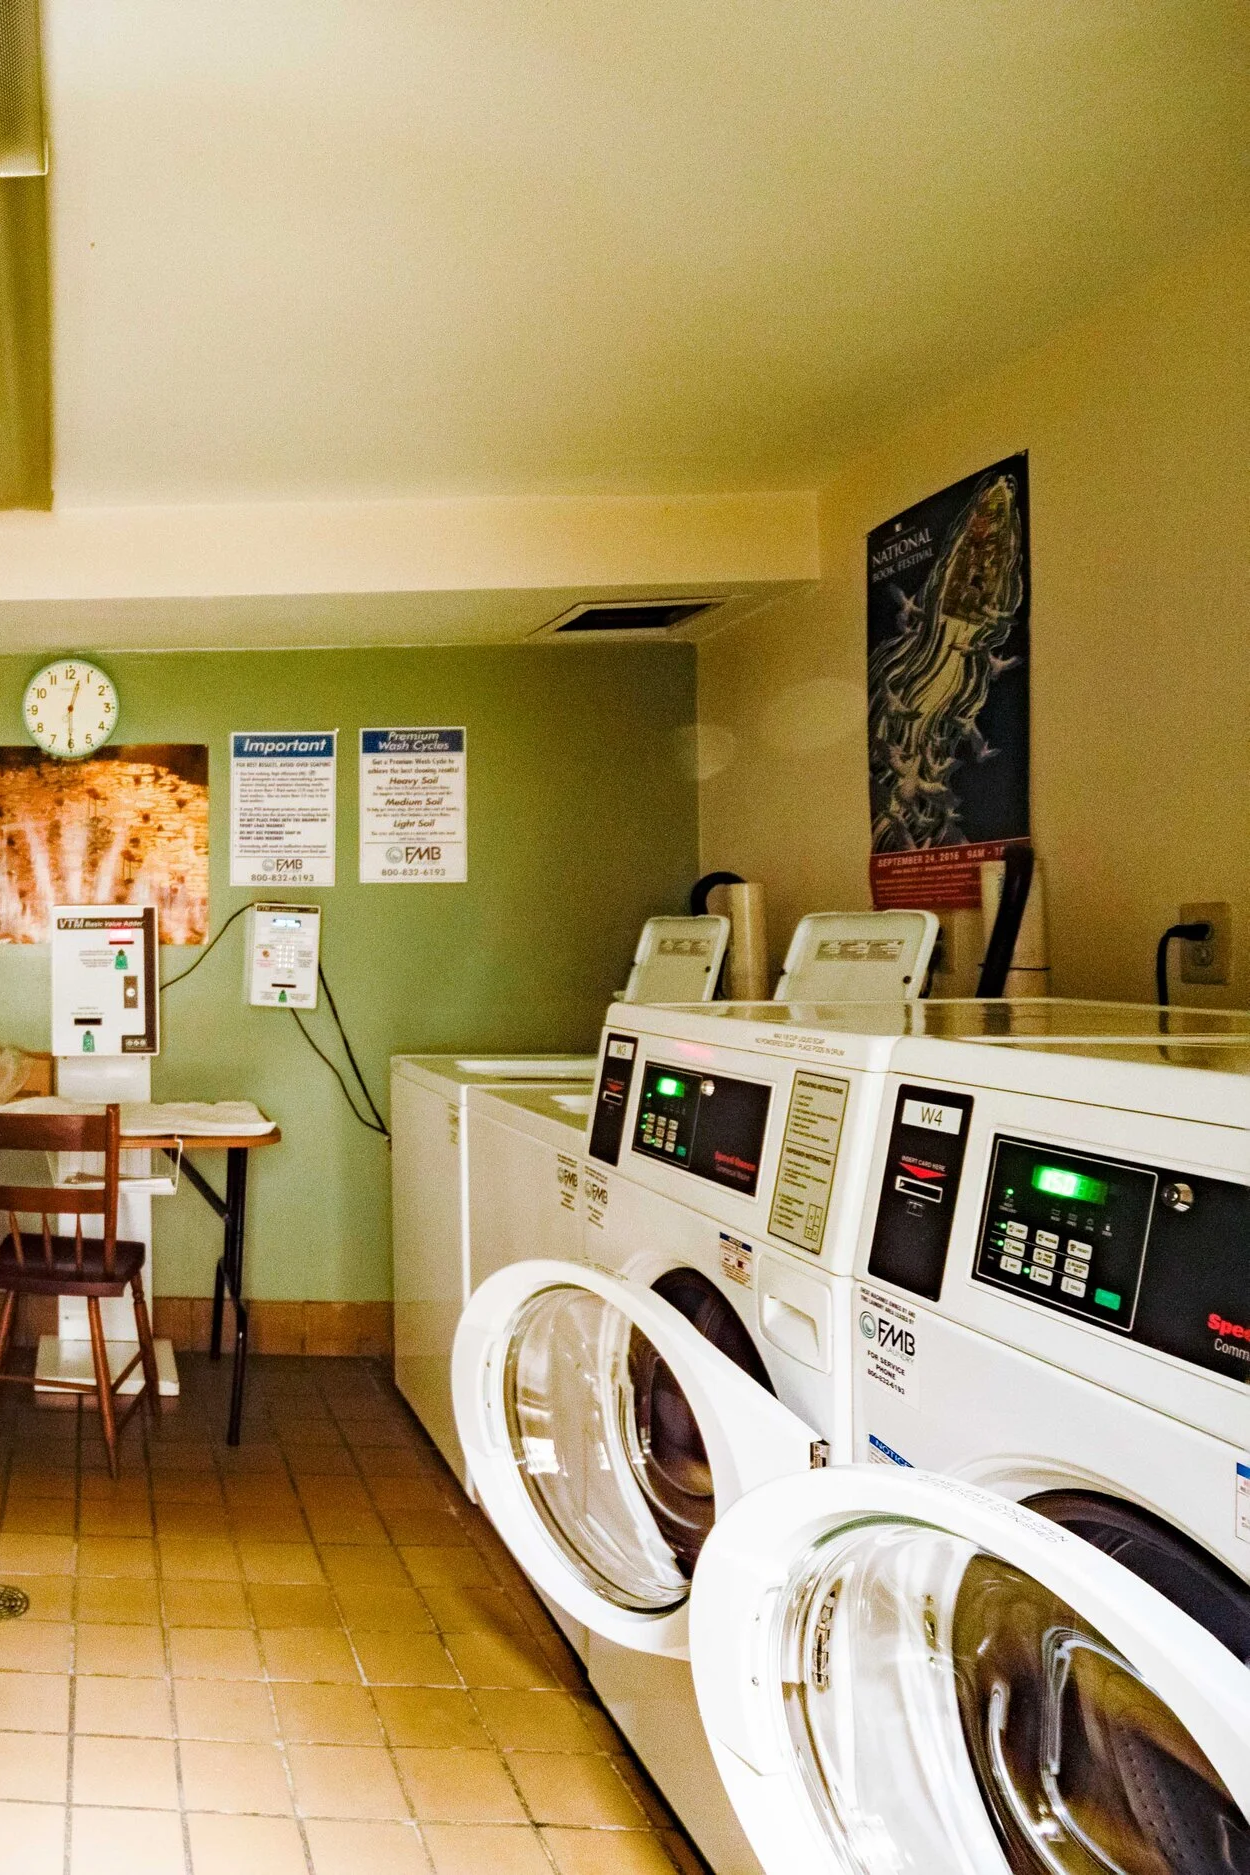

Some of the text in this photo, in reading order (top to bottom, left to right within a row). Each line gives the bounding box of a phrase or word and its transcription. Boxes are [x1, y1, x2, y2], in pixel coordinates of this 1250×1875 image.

[872, 528, 933, 567] NATIONAL
[872, 547, 934, 583] BOOK FESTIVAL
[51, 675, 57, 685] 11
[65, 669, 76, 680] 12
[37, 688, 47, 699] 10
[98, 685, 105, 696] 2
[31, 705, 38, 715] 9
[104, 703, 111, 713] 3
[37, 723, 44, 733] 8
[98, 722, 105, 730] 4
[51, 735, 57, 744] 7
[86, 734, 92, 744] 5
[389, 731, 440, 741] Premium
[243, 739, 327, 755] Important
[379, 741, 450, 752] Wash Cycles
[389, 776, 439, 786] Heavy Soil
[385, 797, 443, 806] Medium Soil
[393, 819, 435, 829] Light Soil
[405, 847, 442, 864] FMB
[878, 855, 923, 868] SEPTEMBER
[966, 849, 985, 859] 9AM
[276, 859, 303, 872] FMB
[251, 874, 315, 882] 800-832-6193
[381, 868, 446, 876] 800-832-6193
[59, 918, 84, 929] VTM
[104, 921, 123, 929] Value
[124, 920, 144, 928] Adder
[921, 1106, 943, 1126] W4
[901, 1155, 946, 1172] INSERT CARD HERE
[564, 1169, 578, 1186] FMB
[592, 1184, 608, 1204] FMB
[868, 1298, 884, 1309] LAUNDRY
[885, 1306, 894, 1315] AREA
[870, 1292, 888, 1304] MACHINES
[889, 1300, 901, 1310] OWNED
[878, 1317, 915, 1356] FMB
[885, 1346, 915, 1366] LAUNDRY
[867, 1350, 905, 1376] FOR SERVICE
[876, 1364, 896, 1380] PHONE
[999, 1503, 1033, 1521] DOOR
[1033, 1520, 1068, 1542] OPEN
[1001, 1511, 1058, 1543] FINISHED
